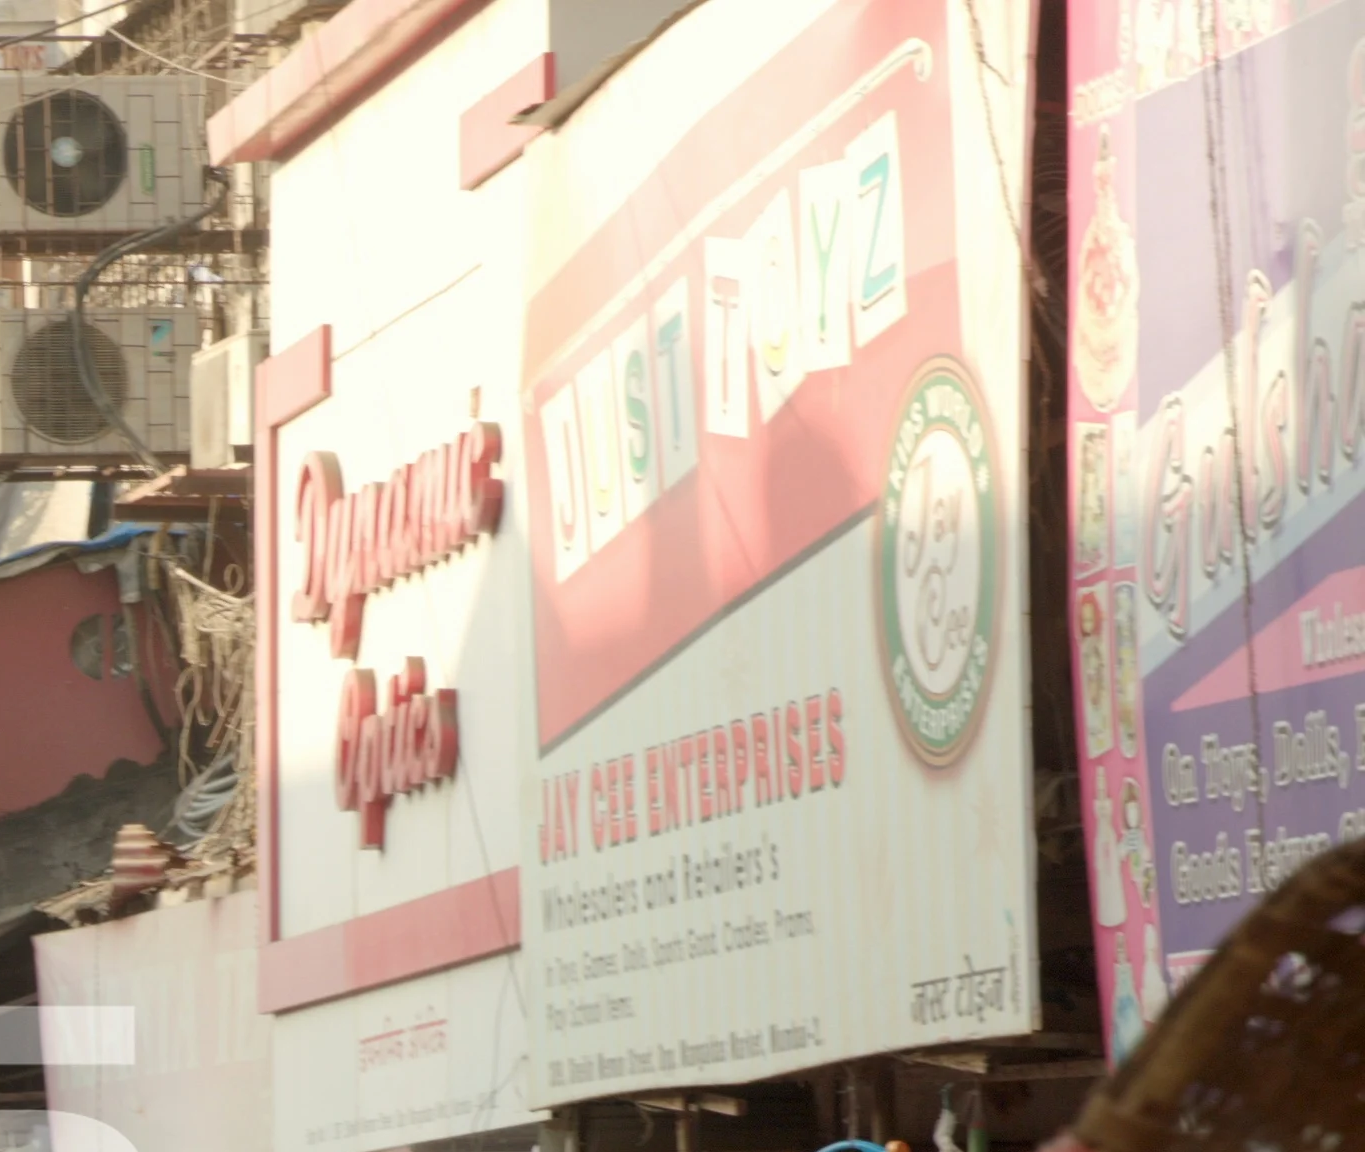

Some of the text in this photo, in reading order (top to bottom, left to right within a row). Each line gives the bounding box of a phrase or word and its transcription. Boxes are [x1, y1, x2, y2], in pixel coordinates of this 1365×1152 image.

[559, 150, 898, 550] JUST TOYZ
[292, 383, 506, 661] Dynamic
[335, 655, 460, 851] Optics
[539, 685, 847, 866] JAY CEE ENTERPRISES
[1161, 741, 1200, 806] On
[541, 870, 640, 932] Wholesalers
[642, 855, 677, 910] and
[1172, 828, 1243, 904] Goods
